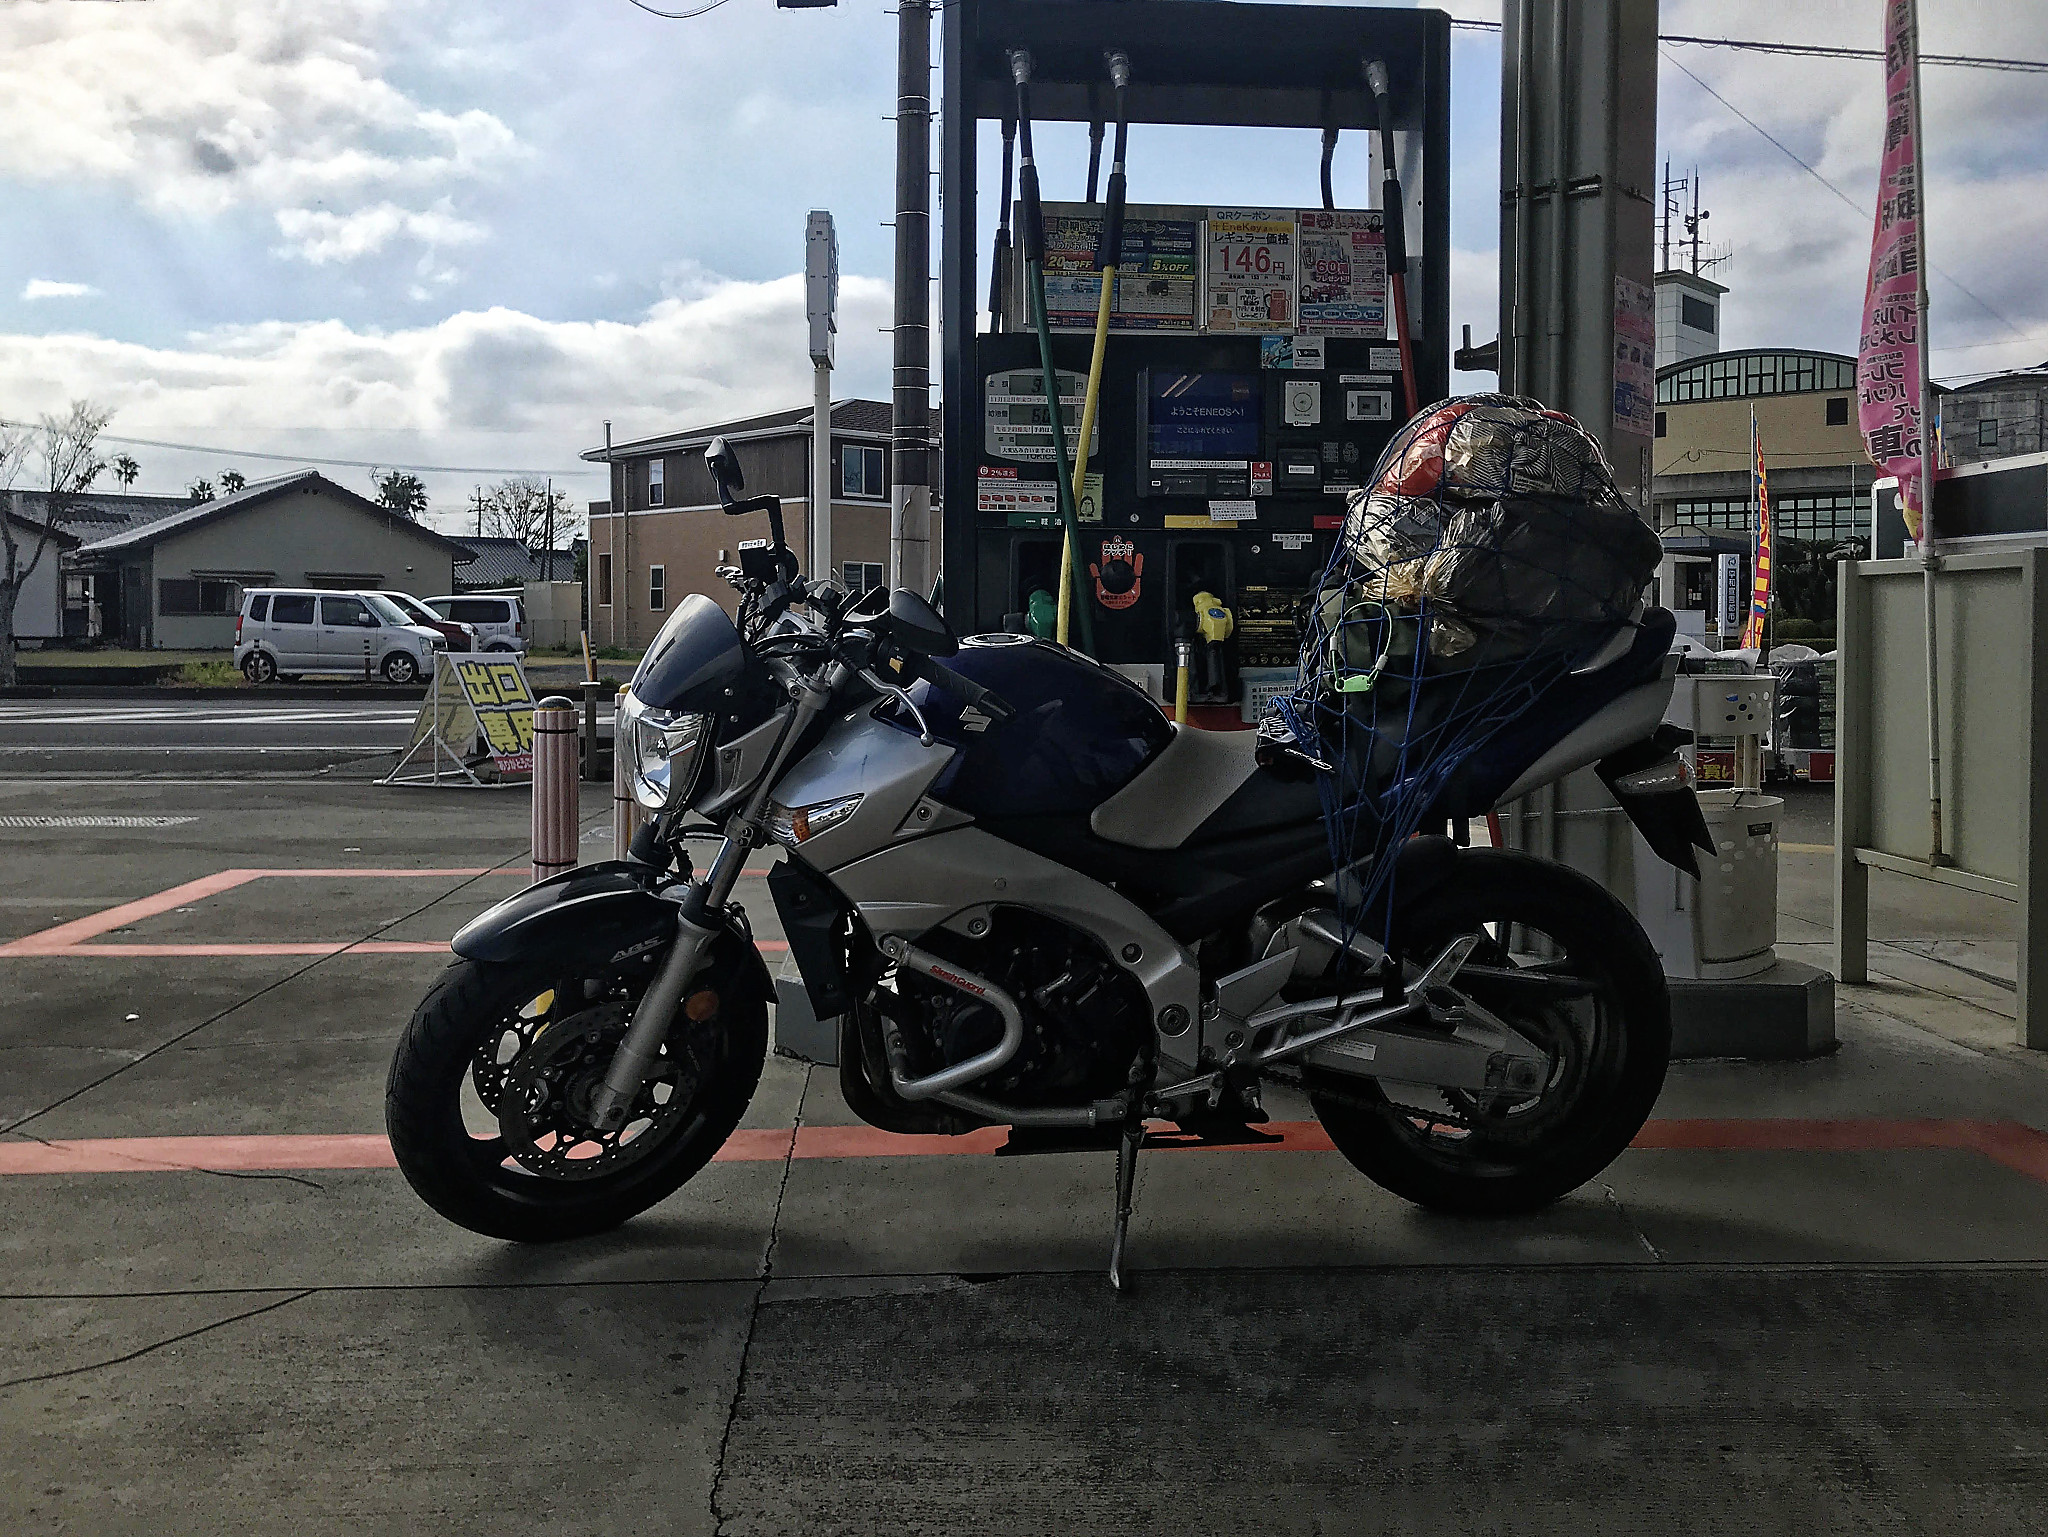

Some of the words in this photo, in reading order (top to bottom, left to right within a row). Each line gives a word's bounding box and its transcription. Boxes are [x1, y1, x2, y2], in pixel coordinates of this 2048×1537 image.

[1217, 211, 1271, 221] QRクーポン
[1214, 232, 1290, 244] レギュラー価格
[1152, 259, 1190, 272] 5%OFF
[1170, 407, 1244, 417] ようこそENEOSへ!
[457, 661, 532, 706] 出口
